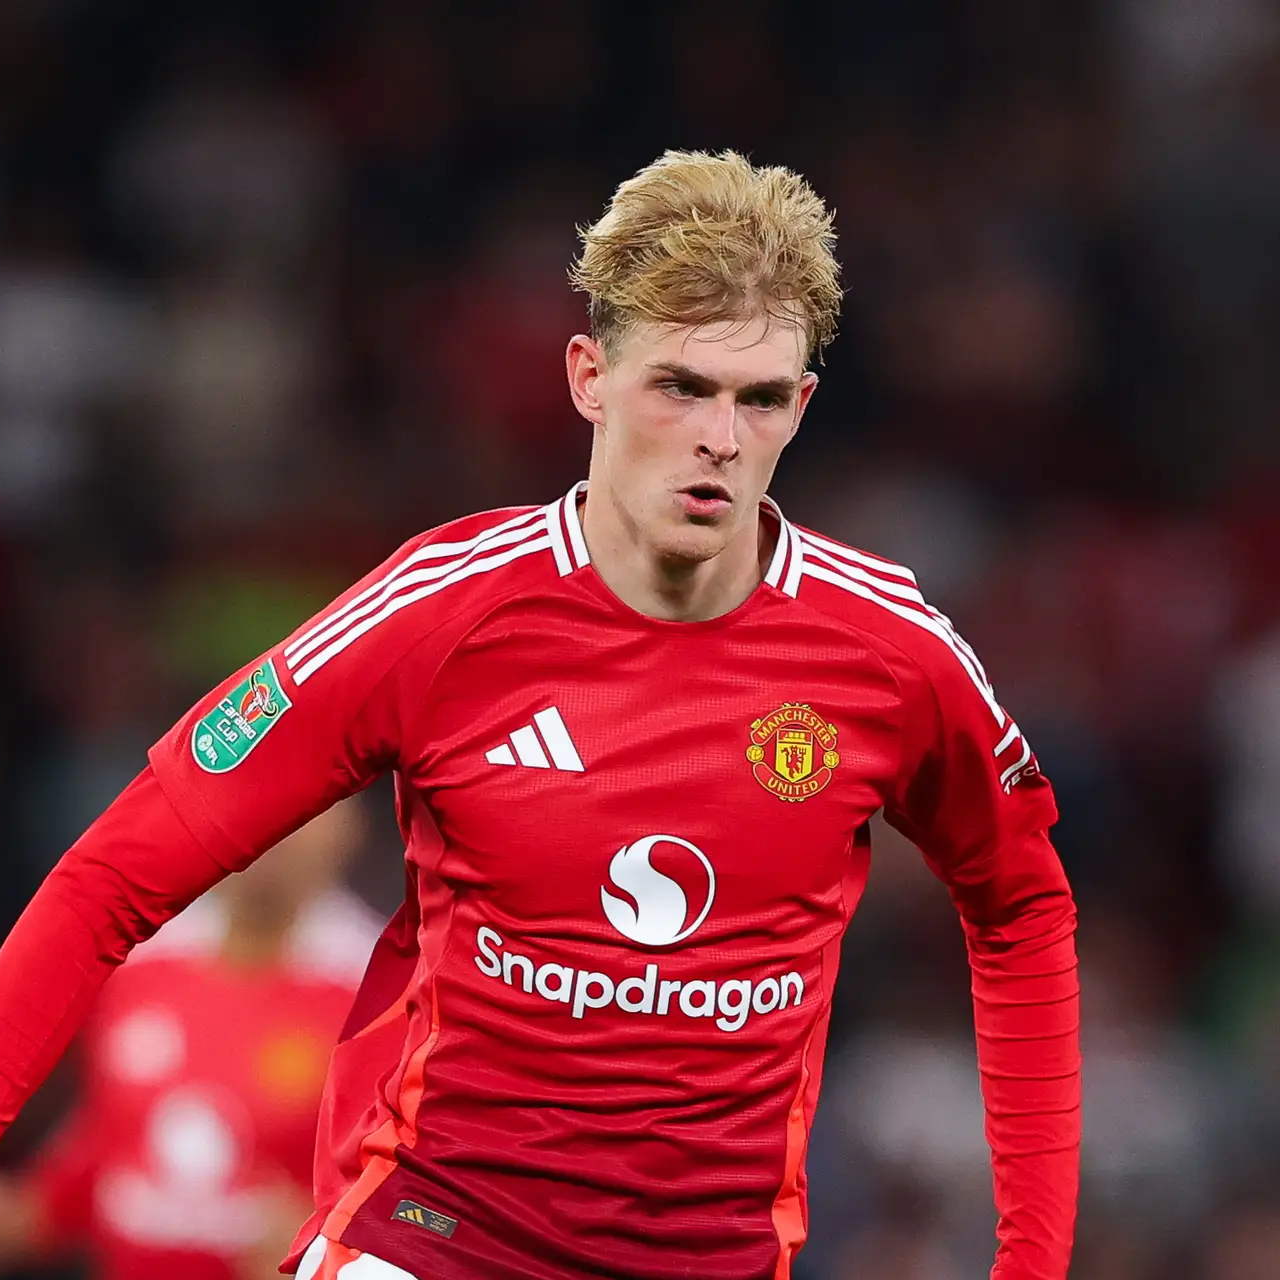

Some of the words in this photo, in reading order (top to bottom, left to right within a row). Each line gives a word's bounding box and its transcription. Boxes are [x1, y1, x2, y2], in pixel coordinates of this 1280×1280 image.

[216, 718, 239, 743] Cup
[218, 698, 257, 740] Carabao
[757, 710, 832, 744] MANCHESTER
[767, 777, 818, 795] UNITED
[474, 926, 805, 1032] Snapdragon
